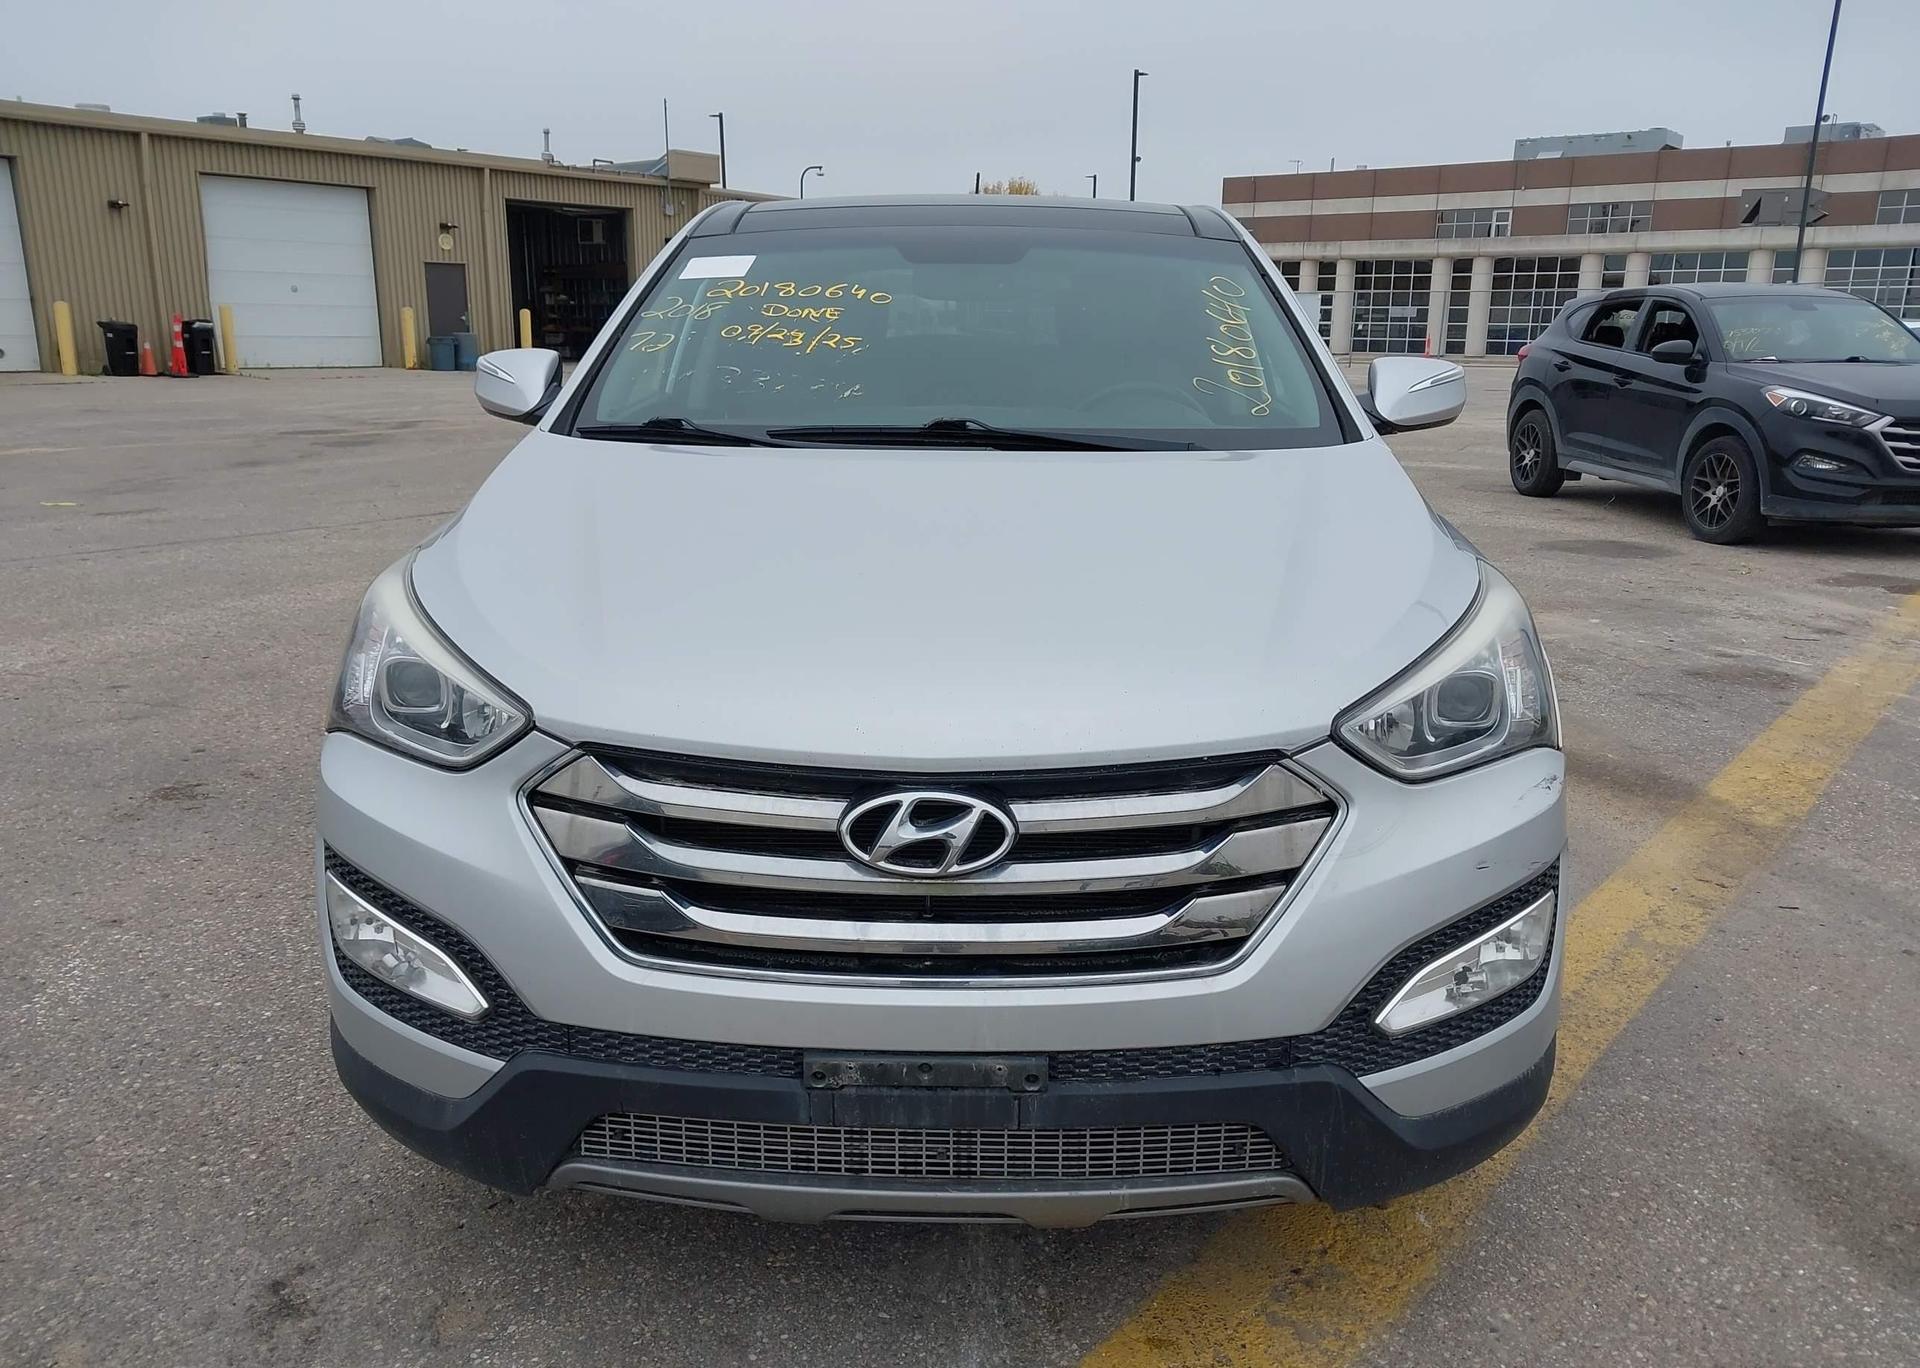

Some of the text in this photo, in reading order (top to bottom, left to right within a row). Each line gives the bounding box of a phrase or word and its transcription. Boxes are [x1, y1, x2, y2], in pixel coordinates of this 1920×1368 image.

[706, 279, 893, 304] 20180640
[761, 303, 844, 323] DONE
[1193, 276, 1272, 416] 20180640
